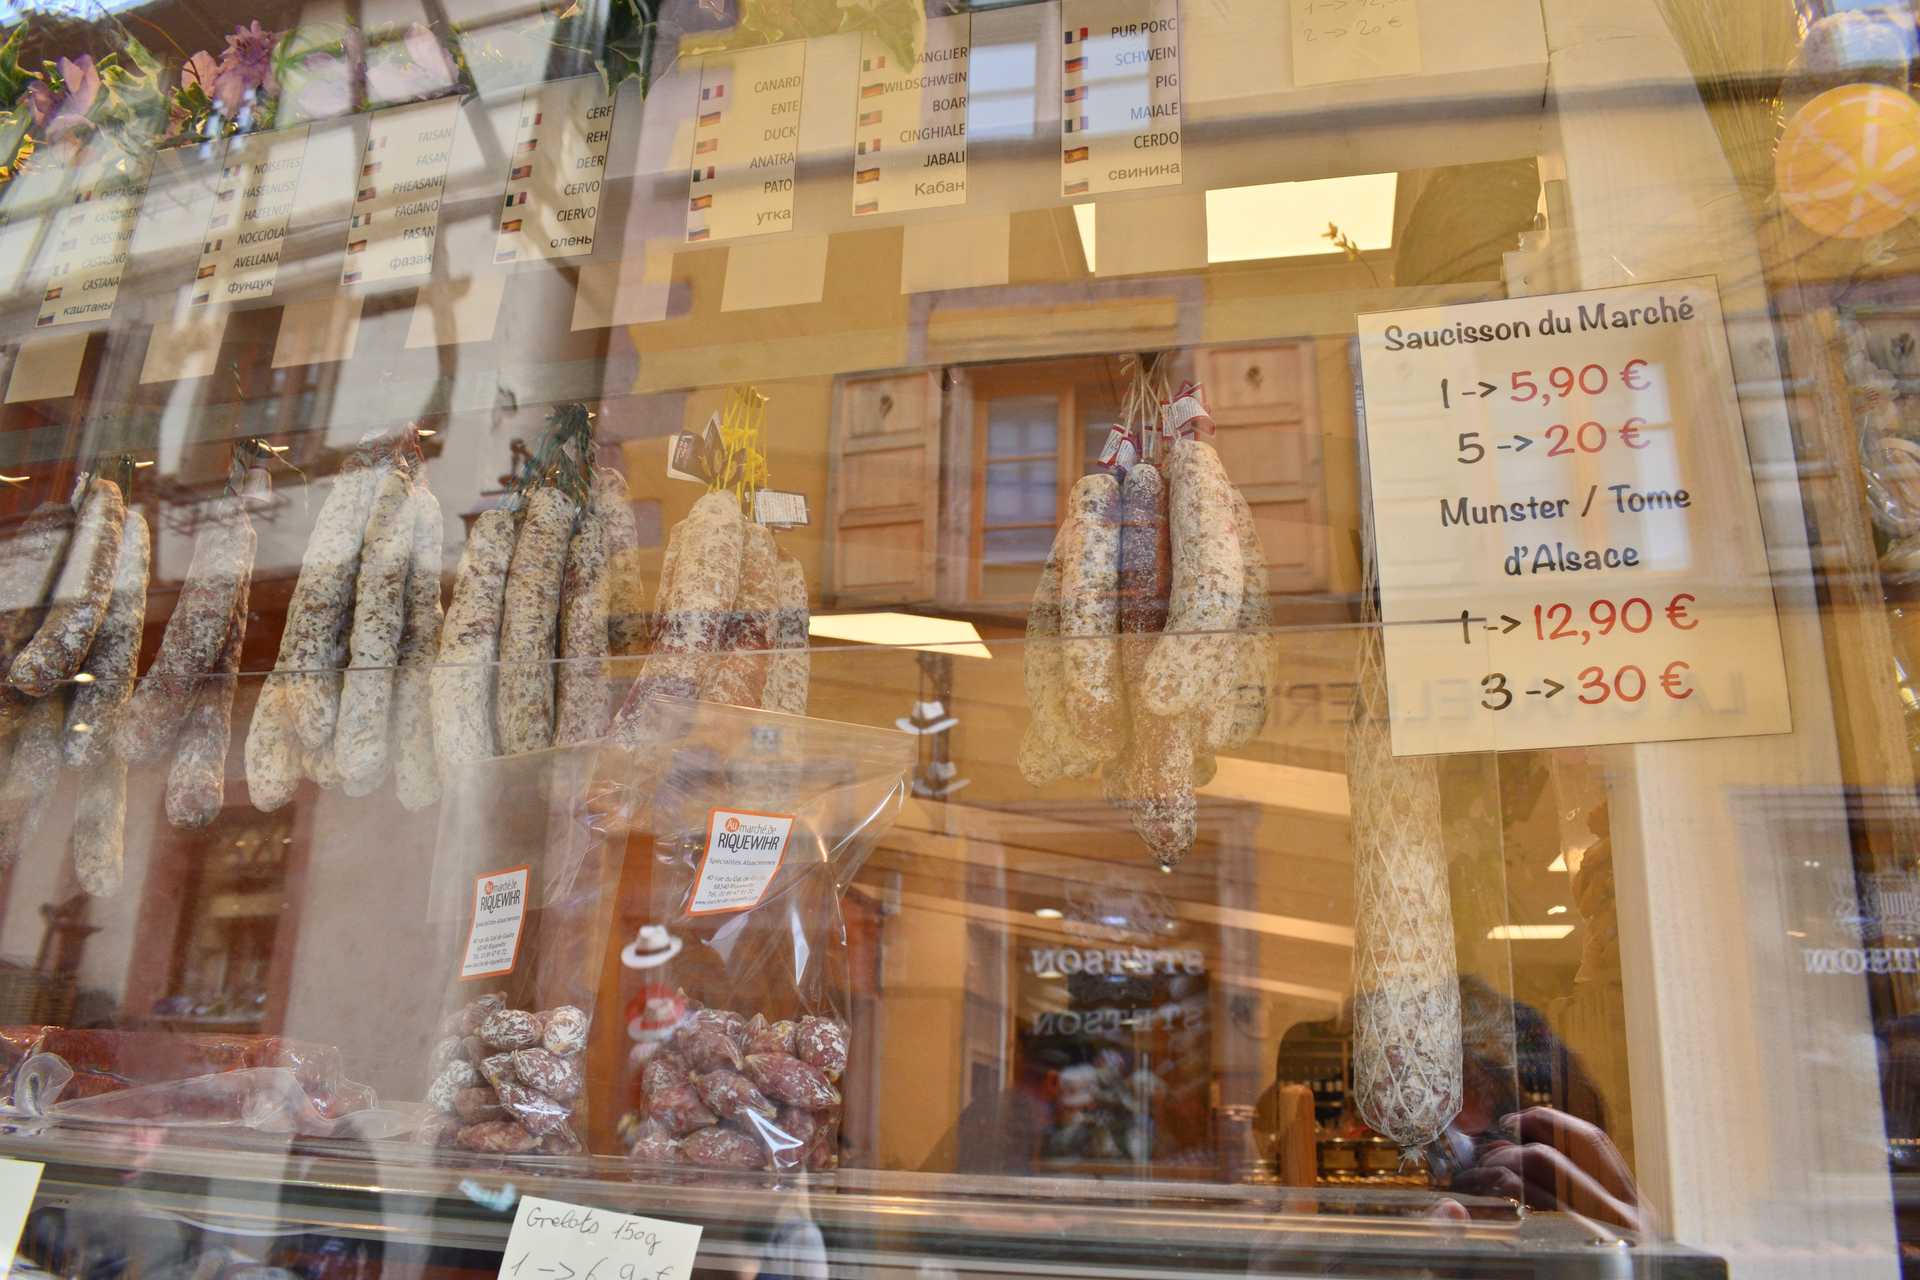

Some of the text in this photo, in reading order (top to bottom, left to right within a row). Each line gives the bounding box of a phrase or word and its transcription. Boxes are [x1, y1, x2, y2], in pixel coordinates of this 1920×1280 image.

[1111, 17, 1177, 39] PUR PORC
[914, 47, 968, 64] ANGLIER
[1115, 47, 1177, 66] SCHWEIN
[754, 76, 801, 93] CANARD
[883, 71, 968, 93] WILDSCHWEIN
[1156, 74, 1178, 88] PIG
[586, 105, 614, 120] CERF
[771, 100, 799, 115] ENTE
[933, 97, 967, 112] BOAR
[1130, 102, 1179, 120] MAIALE
[586, 130, 609, 144] REH
[764, 126, 797, 141] DUCK
[900, 123, 966, 144] CINGHIALE
[1134, 132, 1179, 149] CERDO
[576, 154, 605, 170] DEER
[750, 152, 795, 169] ANATRA
[924, 151, 965, 168] JABALI
[1108, 162, 1181, 181] свинина
[392, 174, 445, 193] PHEASANT
[564, 180, 600, 196] CERVO
[764, 178, 792, 194] PATO
[915, 180, 965, 197] Кабан
[394, 199, 439, 217] FAGIANO
[556, 206, 597, 222] CIERVO
[756, 208, 791, 225] утка
[237, 227, 287, 245] NOCCIOLA
[550, 235, 592, 249] олень
[233, 251, 280, 269] AVELLANA
[227, 277, 273, 294] фундук
[1384, 296, 1696, 352] Saucisson du Marché
[1440, 358, 1652, 409] 1 5,90 €
[1457, 417, 1652, 464] 5 20 €
[1440, 495, 1570, 527] Munster
[1608, 485, 1692, 515] Tome
[1504, 541, 1641, 577] d'Alsace
[1533, 596, 1653, 645] 12,90
[1664, 593, 1699, 631] €
[1480, 660, 1695, 711] 3 30 €
[718, 833, 780, 853] RIQUEWIHR
[480, 890, 521, 914] RIQUEWIHR
[614, 1219, 662, 1256] 150g
